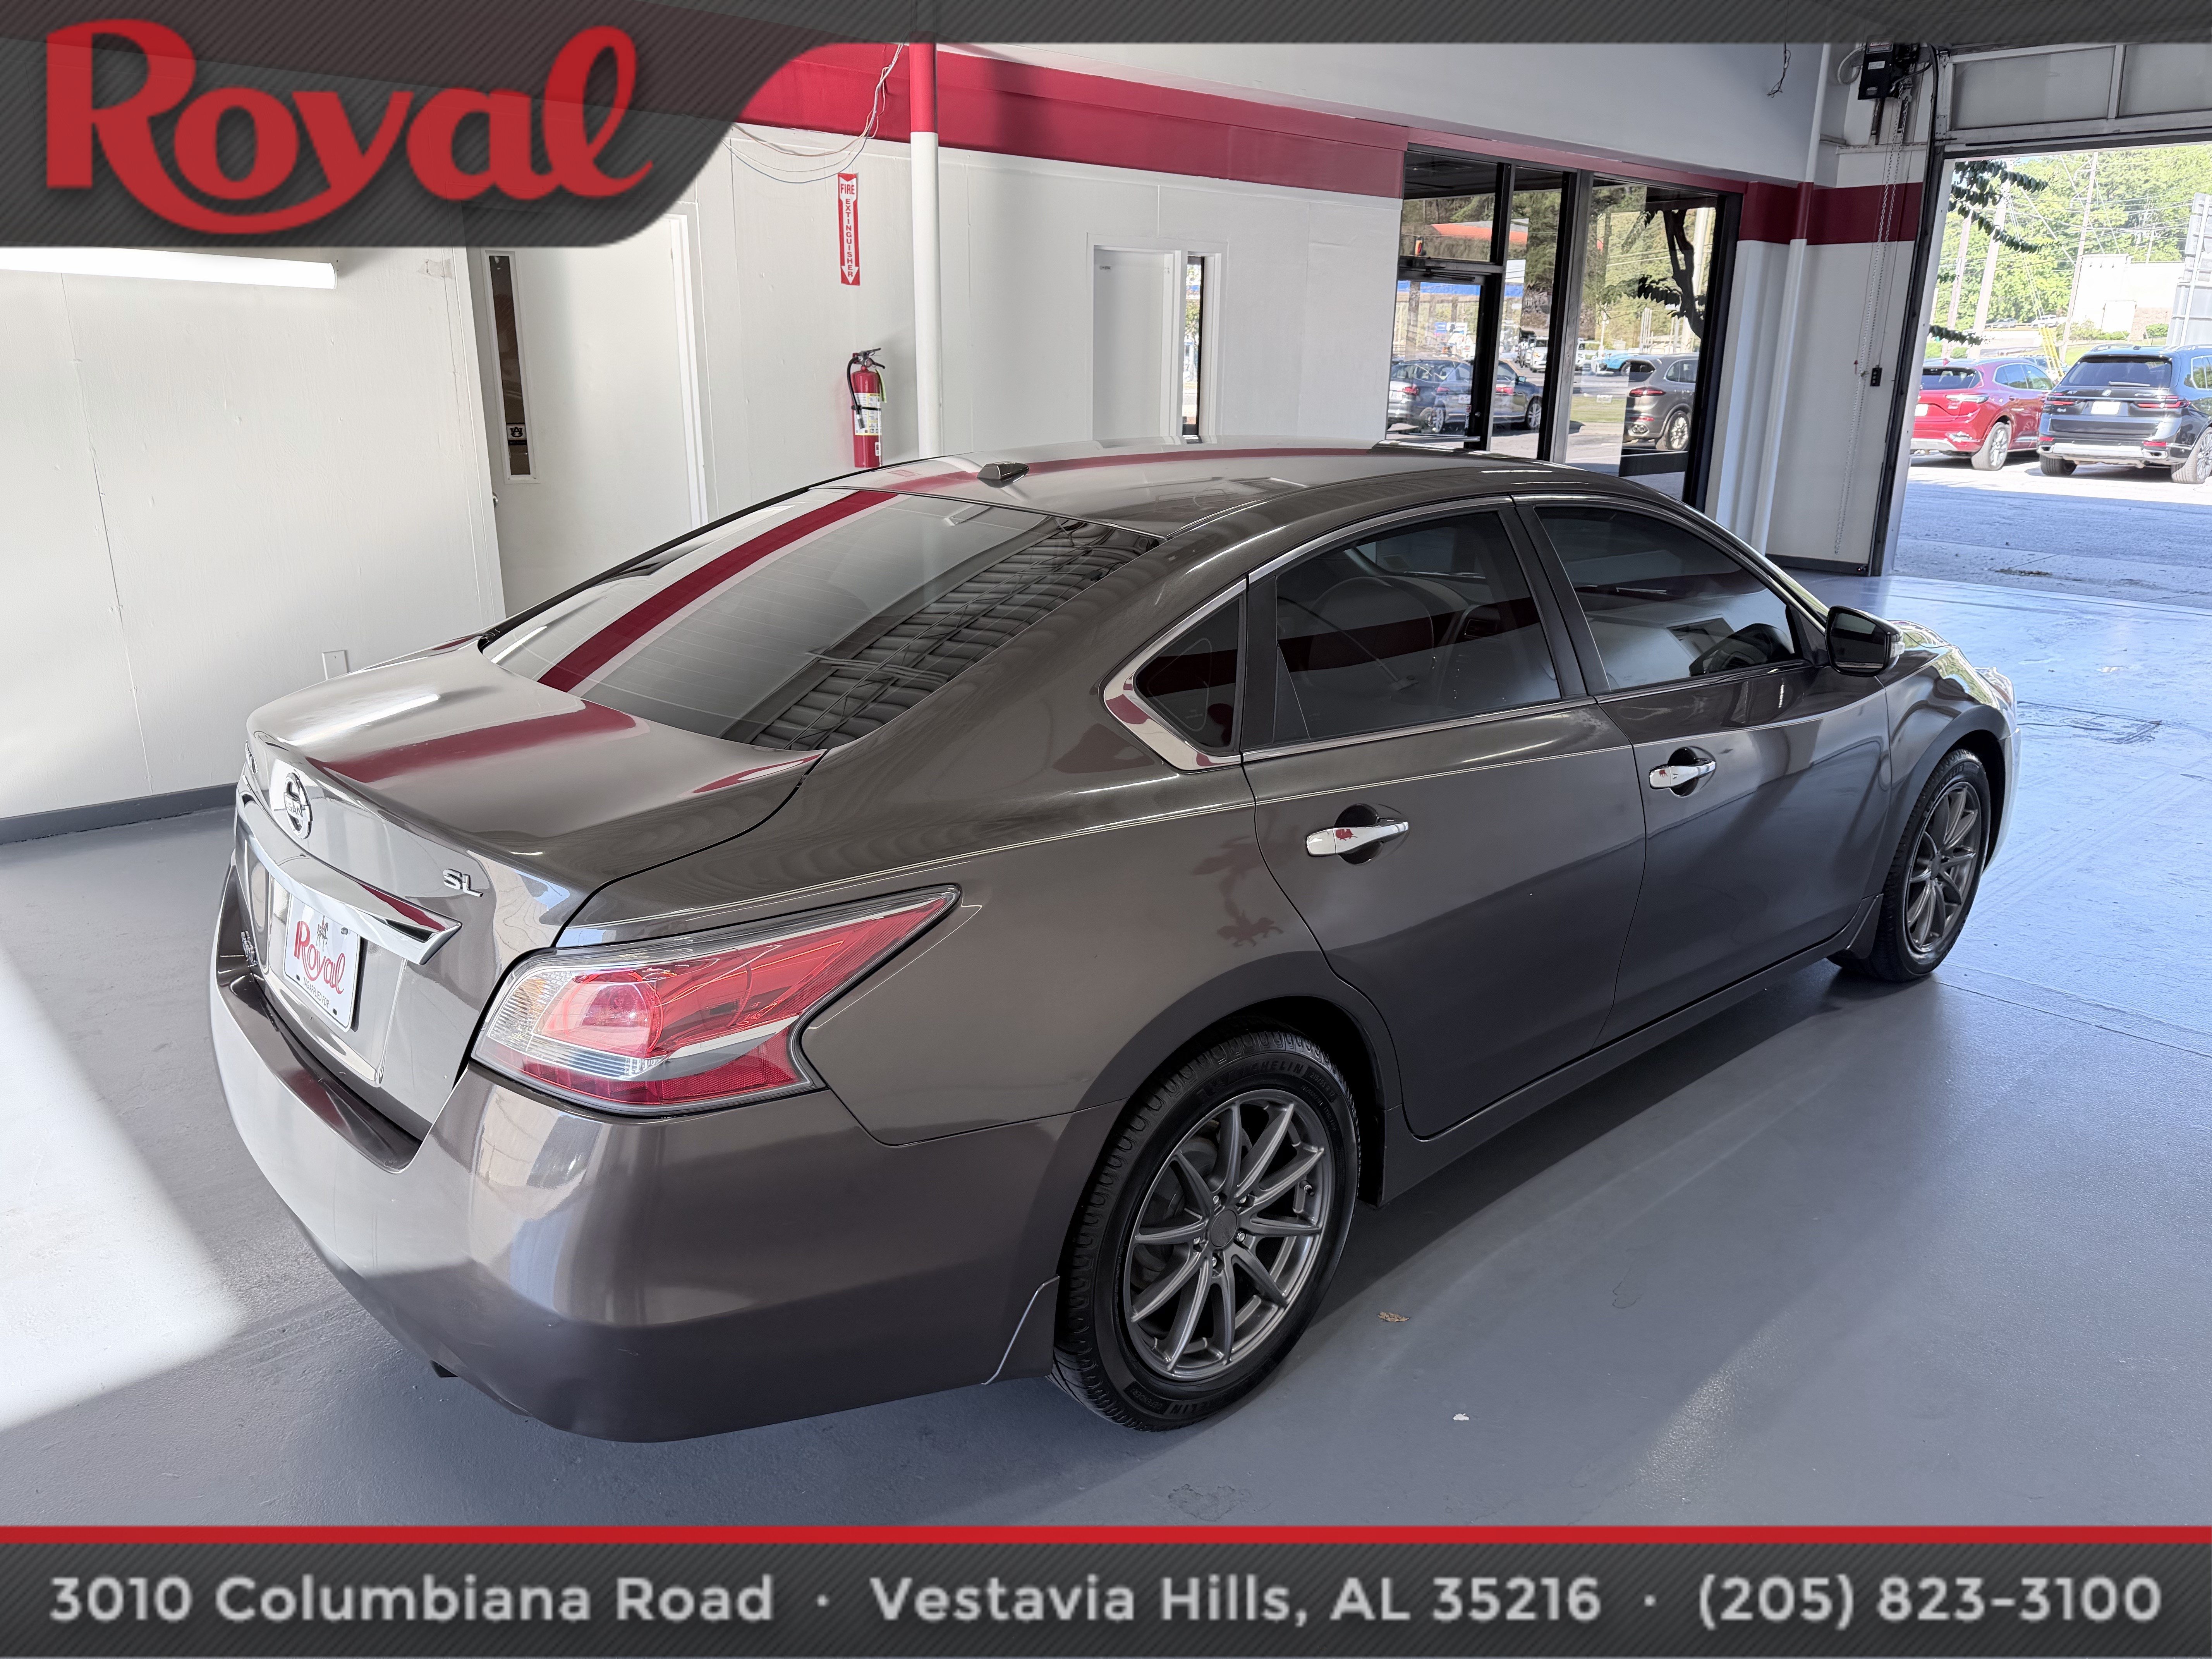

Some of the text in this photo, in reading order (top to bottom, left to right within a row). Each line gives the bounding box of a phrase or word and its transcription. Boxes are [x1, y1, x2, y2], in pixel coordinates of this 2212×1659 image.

[840, 184, 855, 194] FIRE
[845, 198, 853, 277] EXTINGUISHER
[443, 868, 484, 897] SL
[294, 921, 345, 994] Royal
